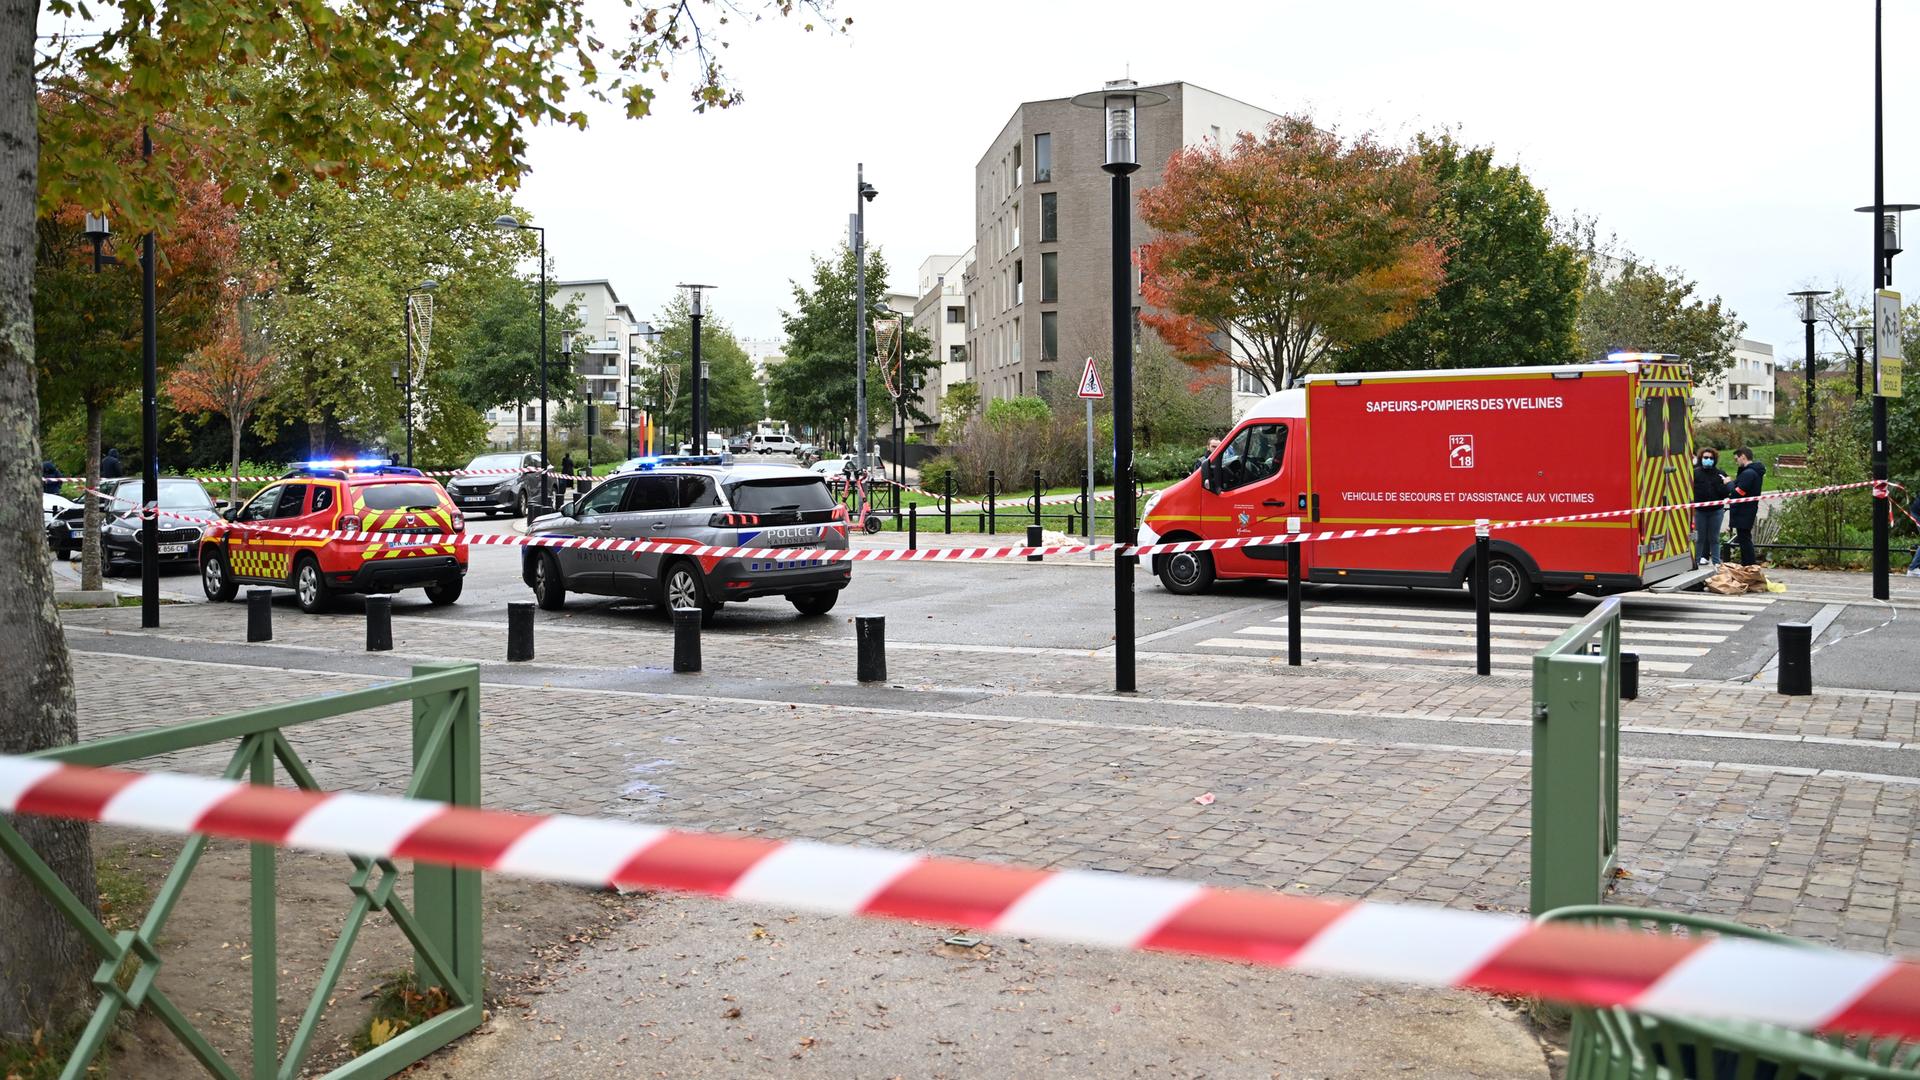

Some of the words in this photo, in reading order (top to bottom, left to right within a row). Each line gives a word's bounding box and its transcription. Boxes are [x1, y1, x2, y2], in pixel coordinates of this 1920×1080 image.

[1366, 399, 1479, 412] SAPEURS-POMPIERS
[1480, 399, 1504, 410] DES
[1505, 396, 1563, 409] YVELINES
[1459, 456, 1471, 466] 18
[1341, 492, 1383, 501] VEHICULE
[1385, 492, 1397, 501] DE
[1399, 492, 1442, 502] SECOURS
[1443, 492, 1455, 502] ET
[1458, 492, 1523, 502] D'ASSISTANCE
[1526, 493, 1545, 503] AUX
[1549, 493, 1594, 503] VICTIMES
[767, 527, 813, 538] POLICE
[577, 551, 626, 563] NATIONALE
